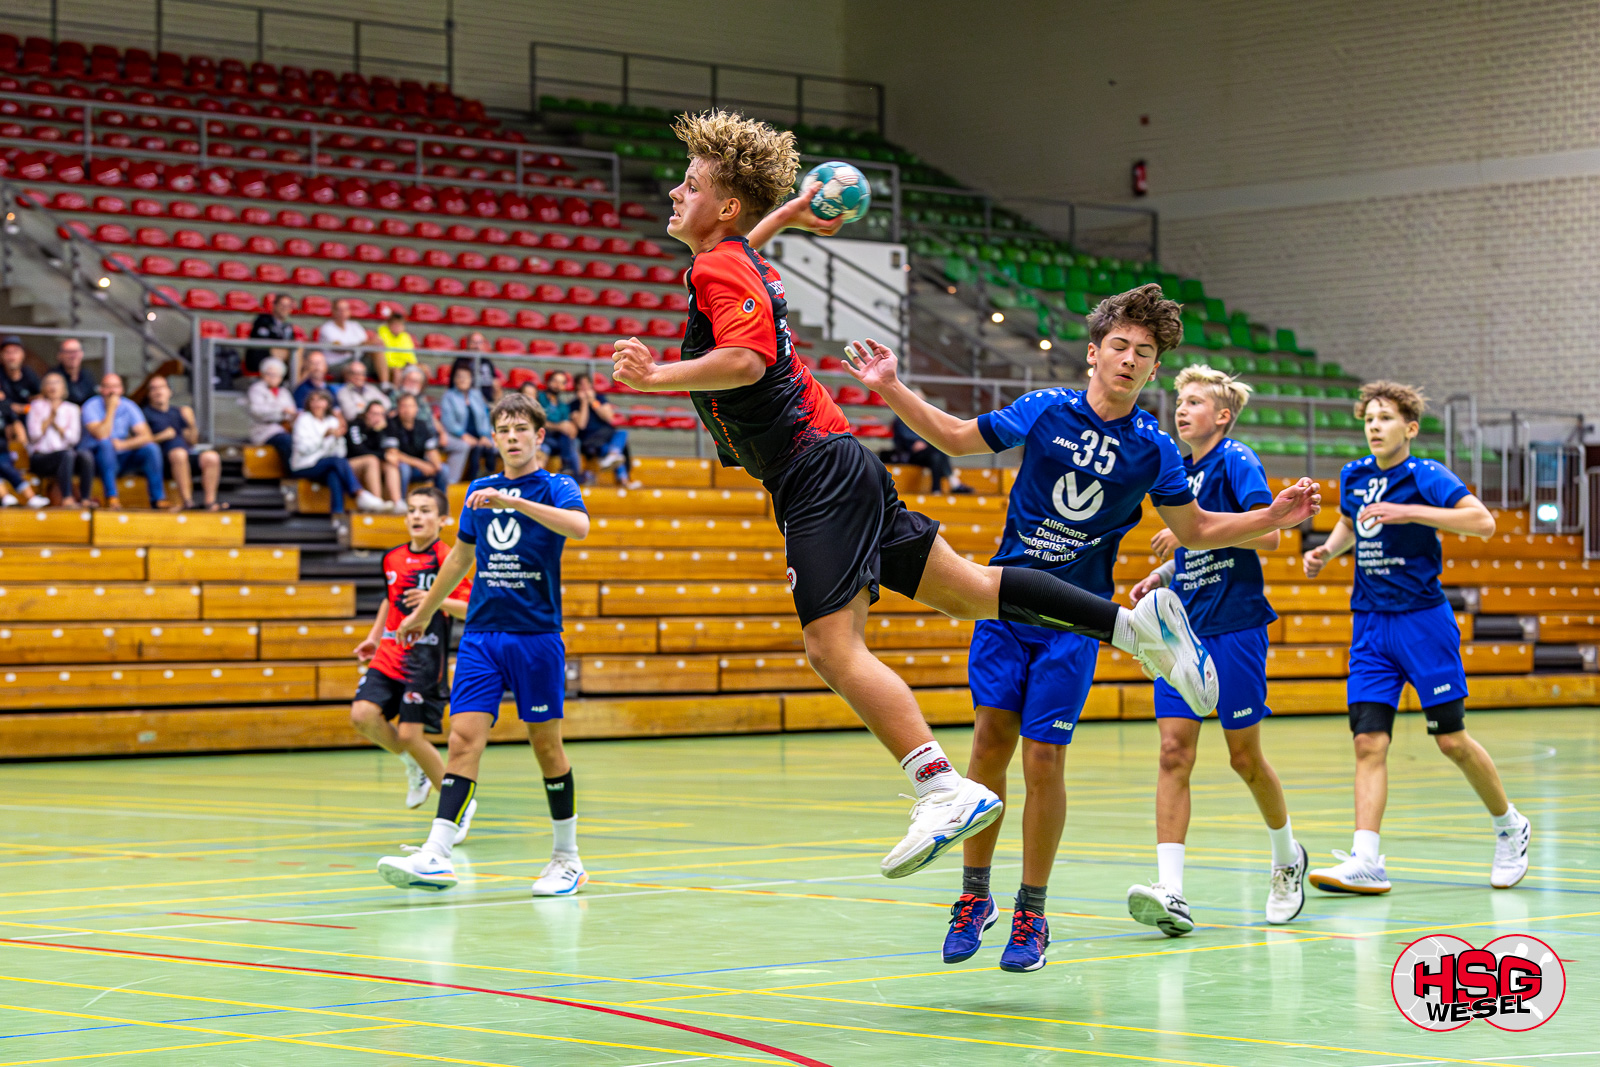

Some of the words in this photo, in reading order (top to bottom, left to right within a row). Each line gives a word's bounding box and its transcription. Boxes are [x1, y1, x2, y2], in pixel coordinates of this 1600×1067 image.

[1052, 436, 1079, 451] JAKO
[1072, 429, 1120, 475] 35
[1042, 518, 1088, 540] Allfinanz
[1232, 707, 1253, 719] JAKO
[1052, 719, 1073, 731] JAKO
